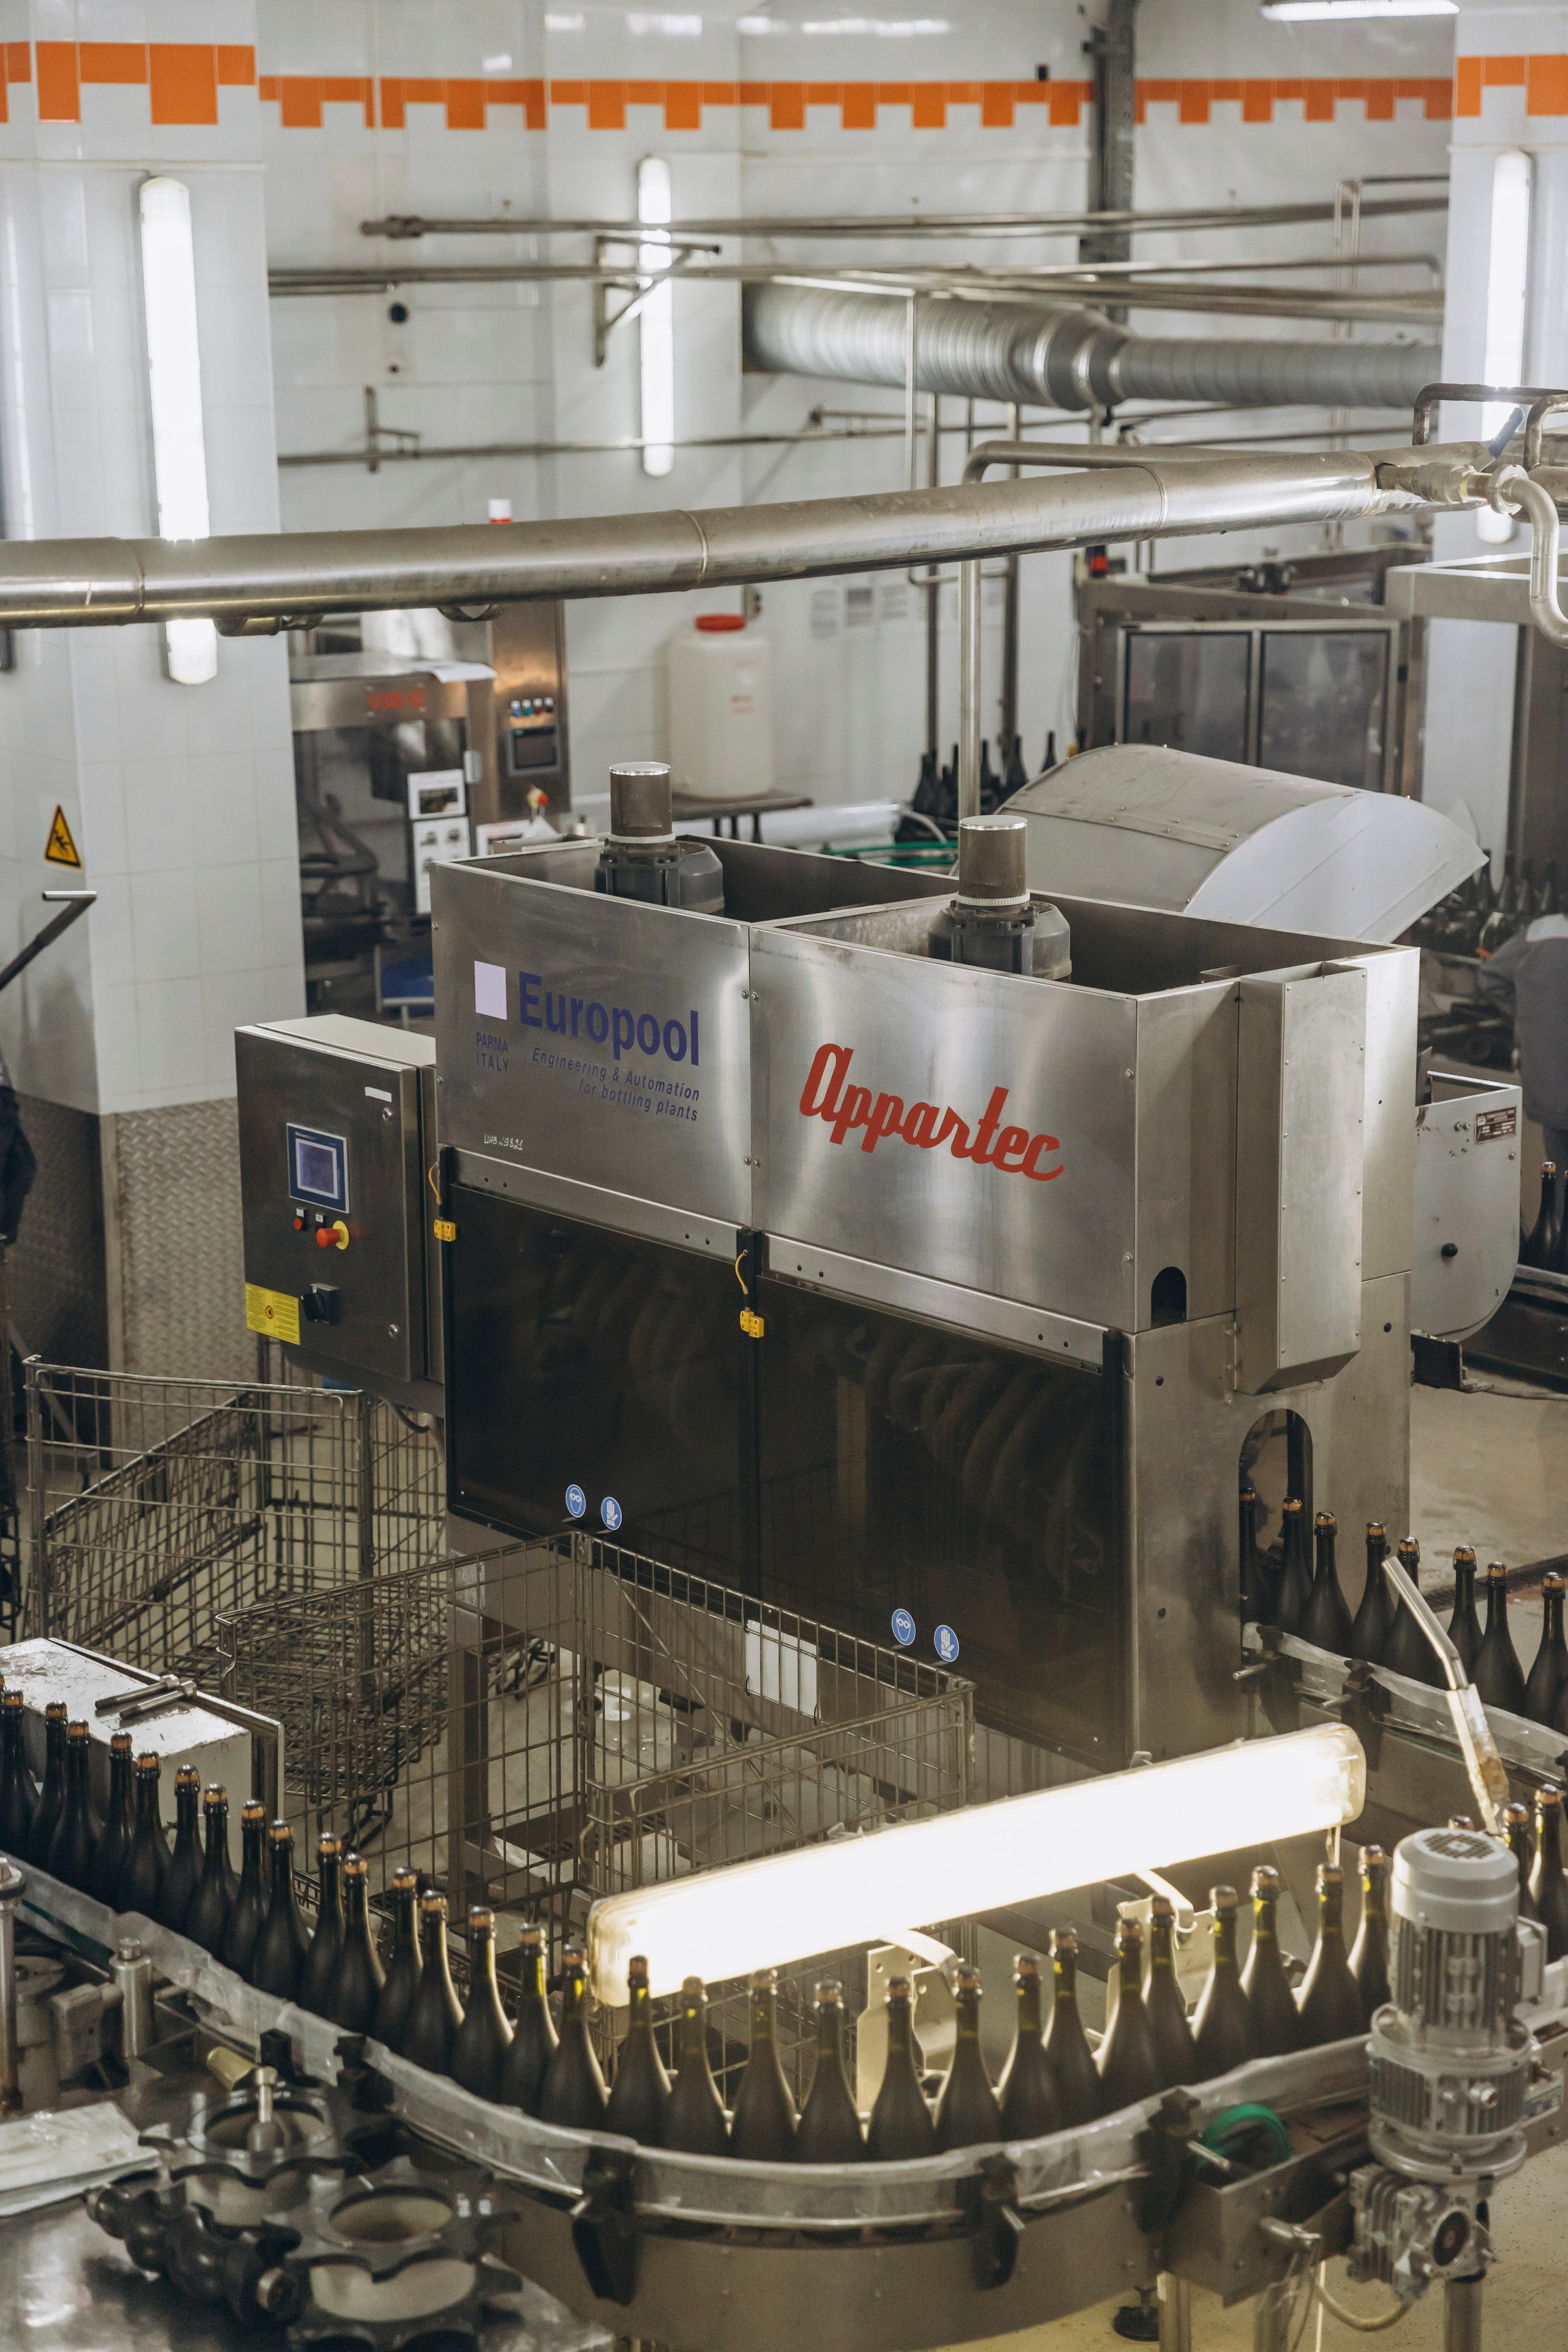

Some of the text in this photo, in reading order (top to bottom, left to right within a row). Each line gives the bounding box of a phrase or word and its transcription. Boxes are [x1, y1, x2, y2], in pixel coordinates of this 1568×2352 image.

[476, 1031, 509, 1054] PARMA
[519, 971, 699, 1066] Europool
[476, 1051, 509, 1073] ITALY
[532, 1047, 699, 1102] Engineering & Automation
[579, 1078, 698, 1121] for bottling plants
[799, 1042, 1065, 1182] Appartec
